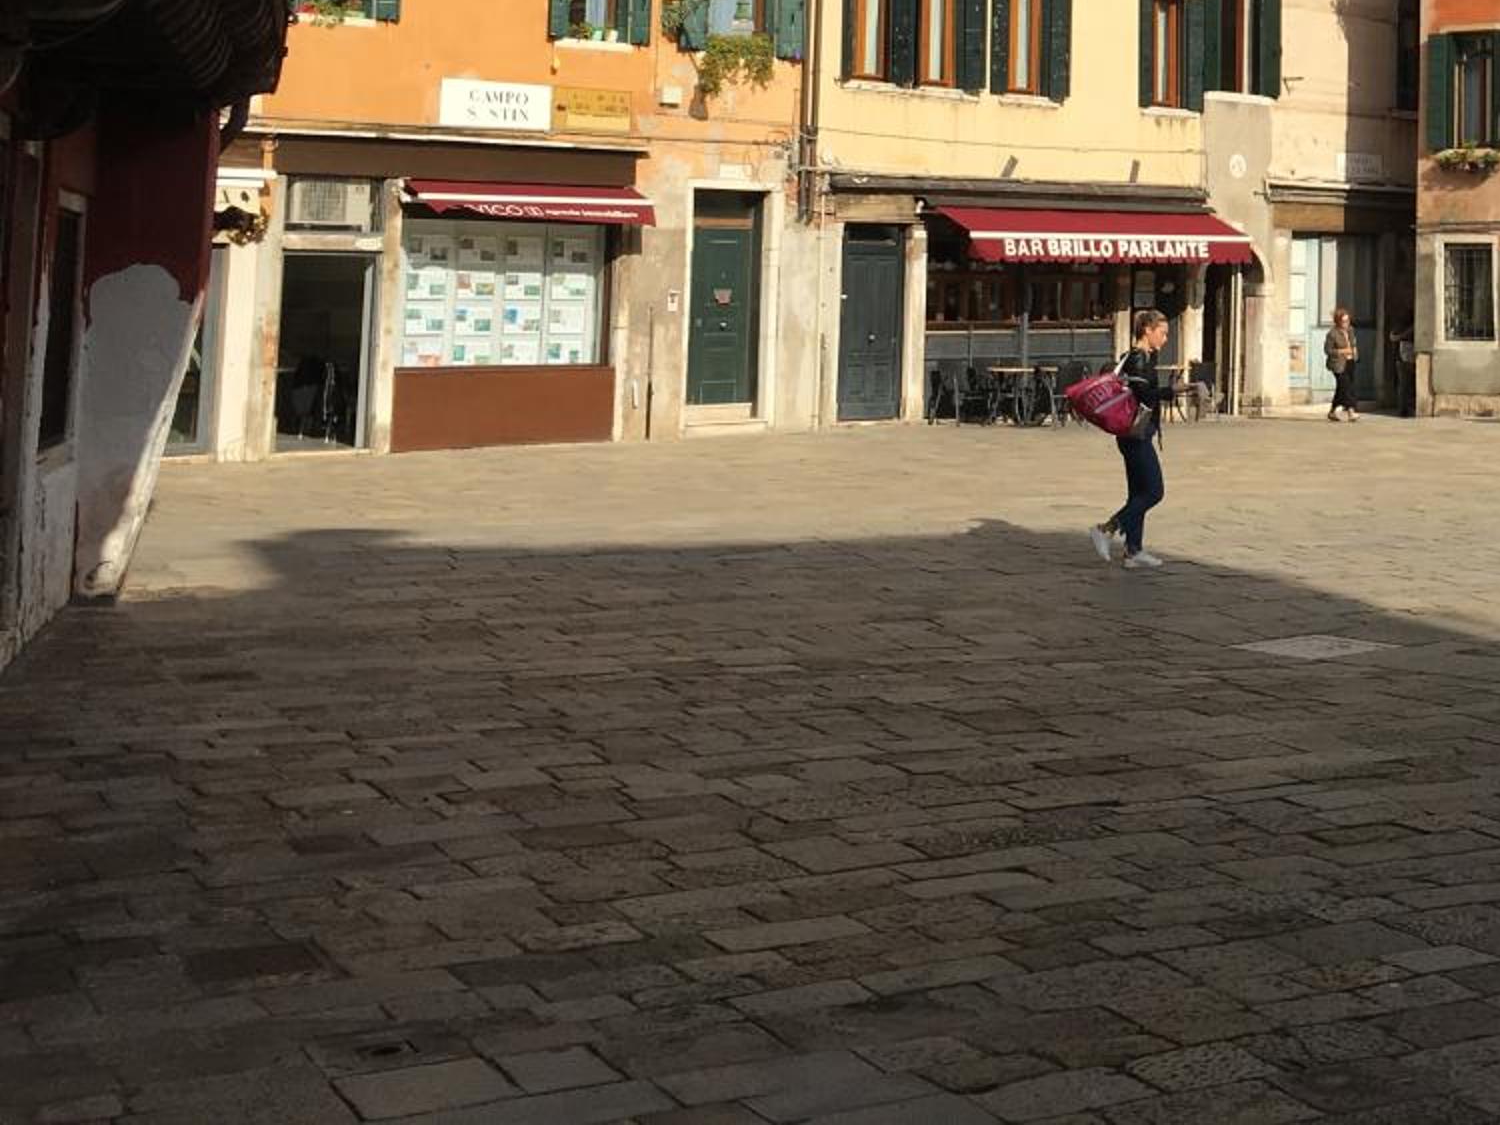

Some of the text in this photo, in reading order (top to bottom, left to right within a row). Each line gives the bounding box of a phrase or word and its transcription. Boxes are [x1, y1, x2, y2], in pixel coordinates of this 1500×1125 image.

[468, 89, 529, 105] CAMPO
[1004, 238, 1210, 258] BAR BRILLO PARLANTE
